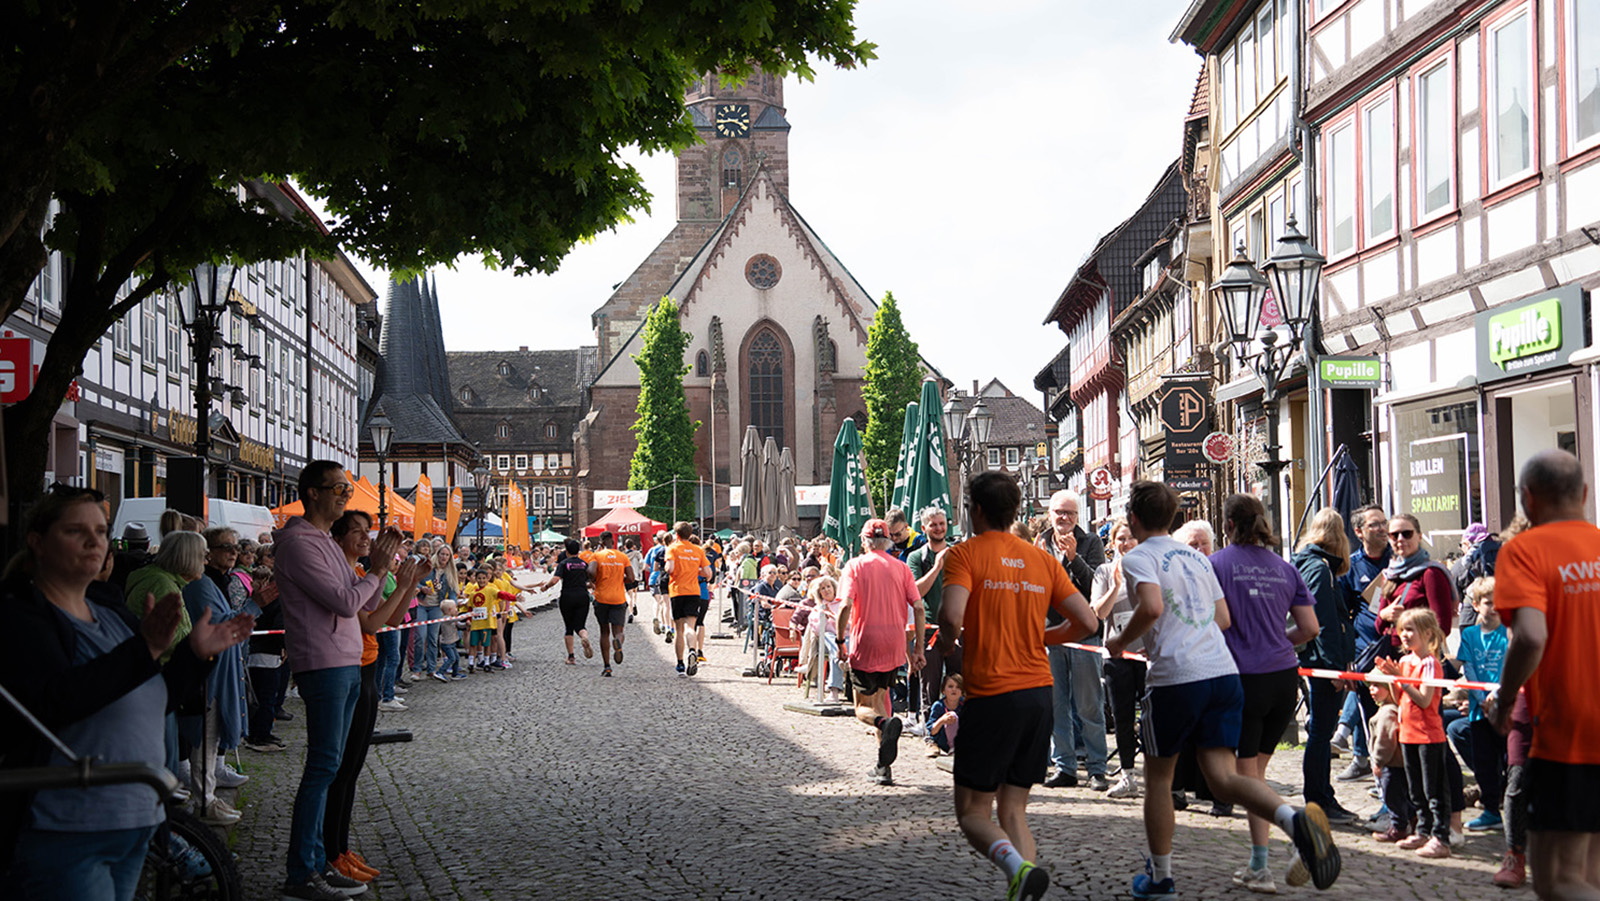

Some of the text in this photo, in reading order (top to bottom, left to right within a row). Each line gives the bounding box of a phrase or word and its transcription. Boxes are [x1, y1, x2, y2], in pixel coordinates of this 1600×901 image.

[1491, 307, 1549, 355] Pupille
[1326, 362, 1375, 379] Pupille
[1410, 478, 1428, 495] ZUM
[607, 494, 634, 505] ZIEL
[1411, 495, 1459, 513] SPARTARIF!
[617, 522, 641, 533] Ziel
[1001, 556, 1025, 569] KWS
[1558, 560, 1600, 582] KWS
[984, 579, 1045, 594] Running Team
